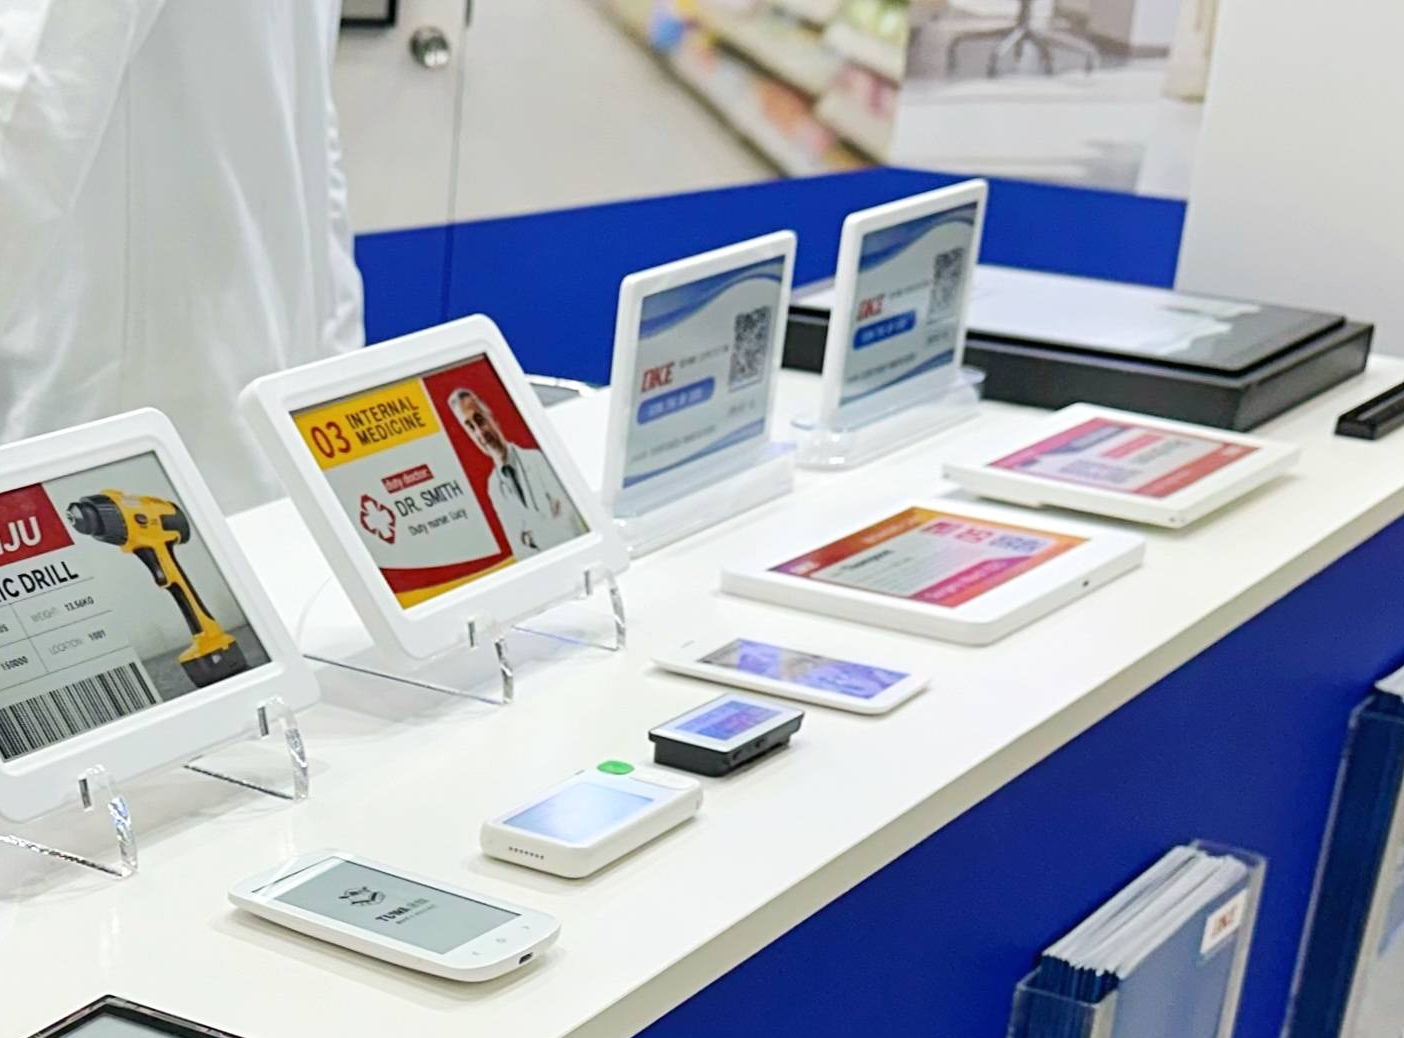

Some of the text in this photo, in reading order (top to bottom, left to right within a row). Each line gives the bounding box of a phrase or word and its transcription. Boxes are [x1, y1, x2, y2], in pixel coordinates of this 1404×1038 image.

[346, 396, 419, 429] INTERNAL
[356, 412, 426, 446] MEDICINE
[311, 421, 351, 458] 03
[420, 480, 464, 508] SMITH
[17, 561, 79, 594] DRILL
